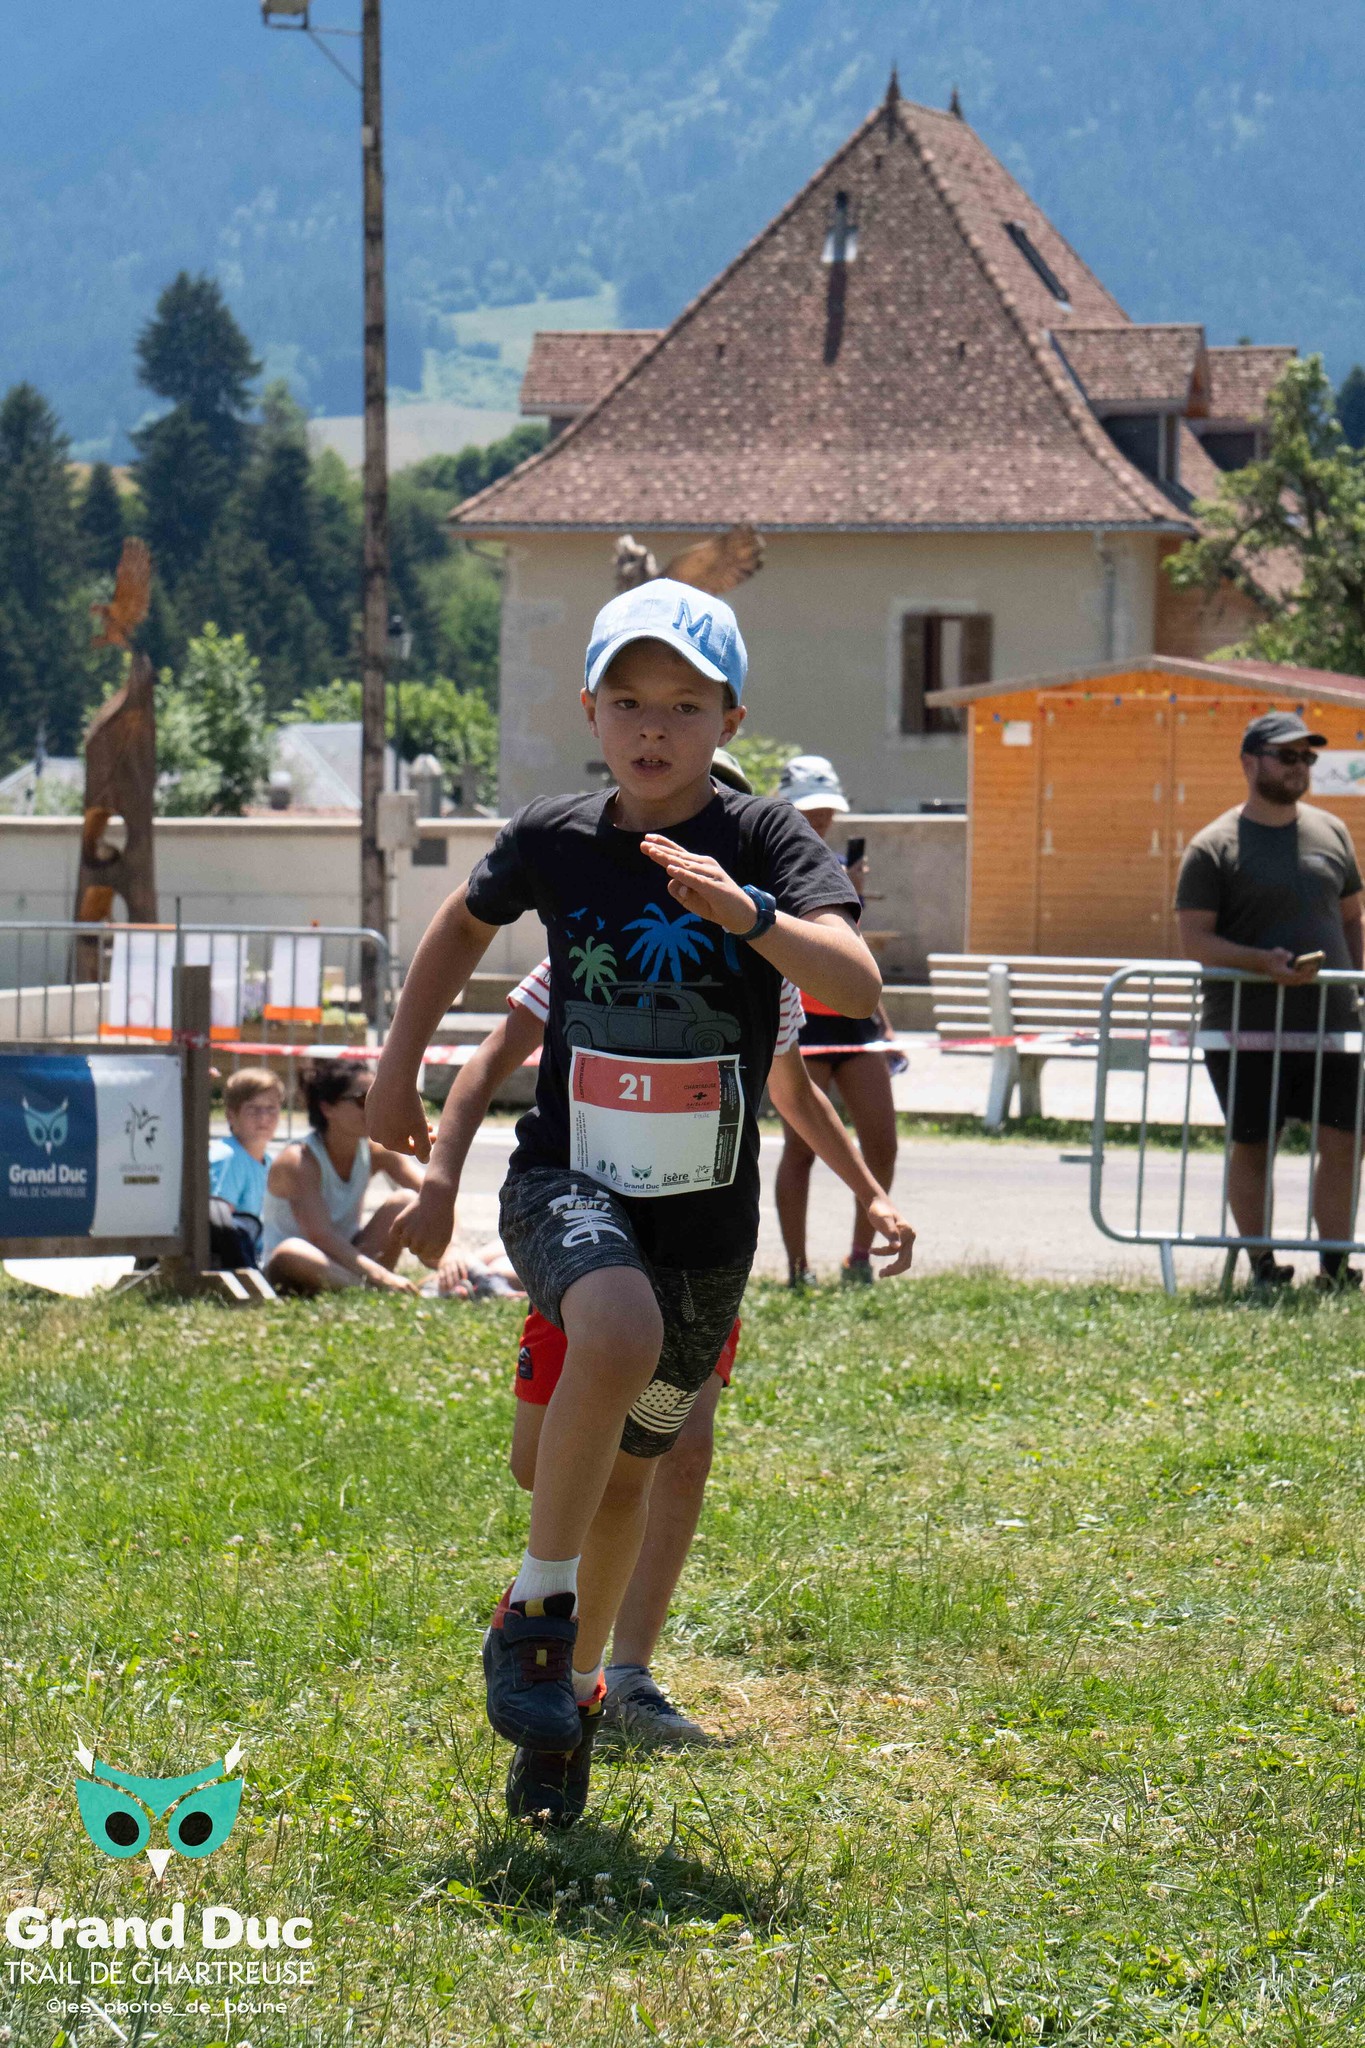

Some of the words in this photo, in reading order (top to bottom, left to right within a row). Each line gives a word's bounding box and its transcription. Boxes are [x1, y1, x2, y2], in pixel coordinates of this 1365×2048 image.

[618, 1073, 651, 1102] 21
[9, 1163, 56, 1184] Grand
[58, 1164, 88, 1184] Duc
[663, 1173, 689, 1182] isère
